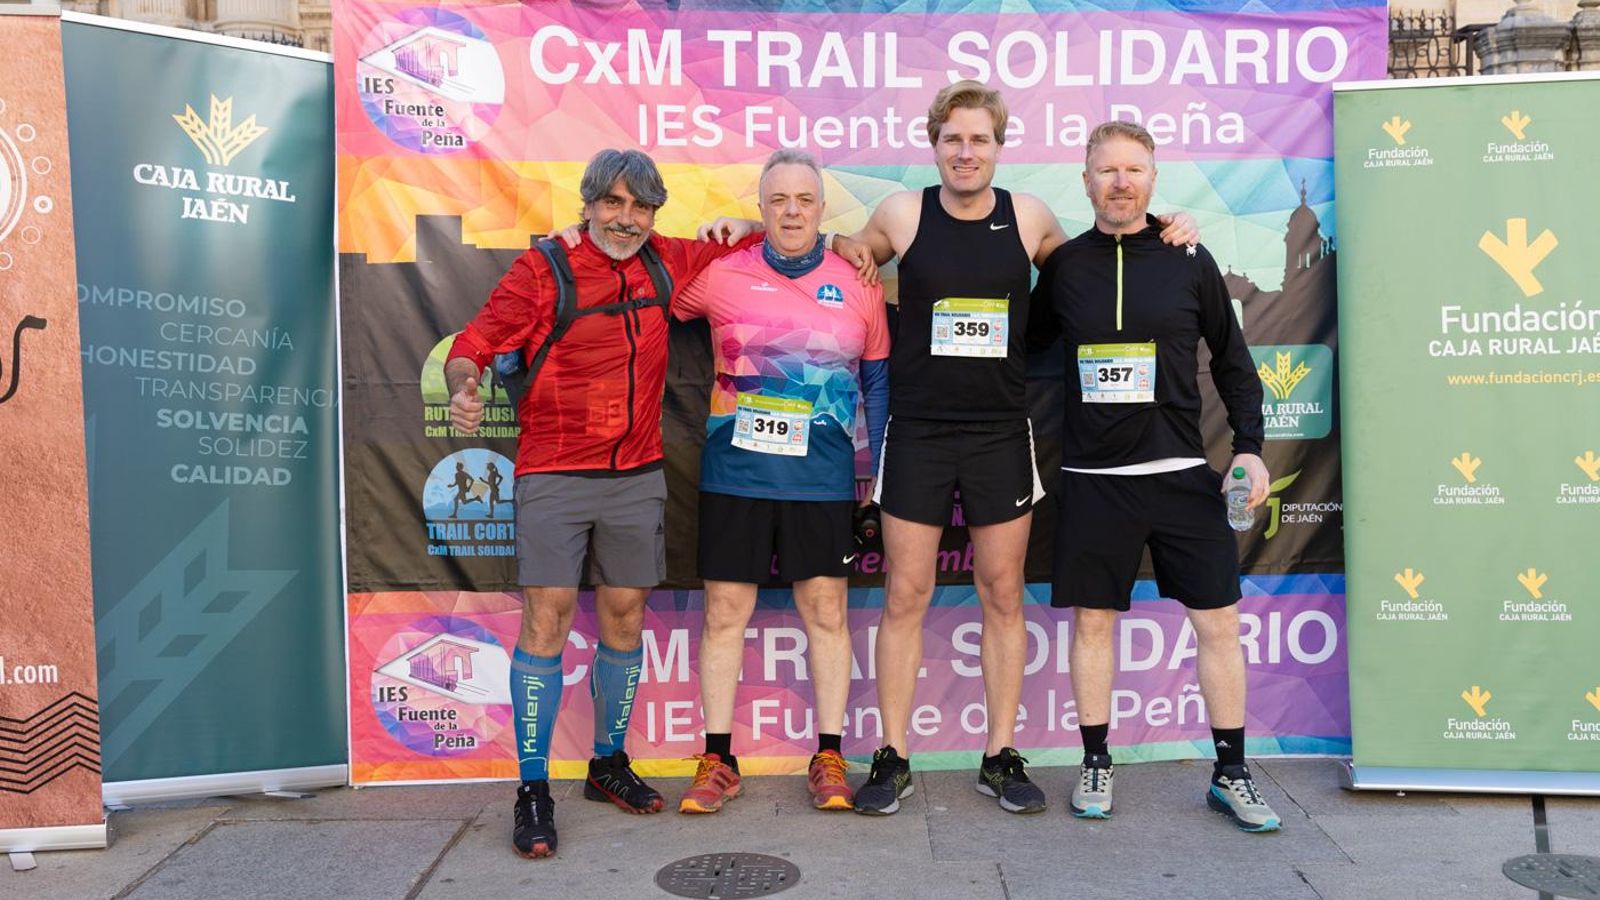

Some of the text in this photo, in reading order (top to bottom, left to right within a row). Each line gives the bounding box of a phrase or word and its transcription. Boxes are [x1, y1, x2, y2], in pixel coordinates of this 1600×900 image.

[529, 25, 1348, 88] CxM TRAIL SOLIDARIO
[365, 77, 394, 94] IES
[385, 99, 444, 117] Fuente
[421, 119, 445, 127] de la
[638, 104, 723, 147] IES
[745, 106, 932, 149] Fuente
[1003, 115, 1025, 148] e
[1045, 103, 1087, 147] la
[422, 131, 464, 147] Peña
[1368, 145, 1429, 160] Fundación
[1487, 140, 1549, 154] Fundación
[1363, 159, 1384, 168] CAJA
[1385, 158, 1412, 167] RURAL
[1482, 154, 1504, 162] CAJA
[1505, 153, 1531, 161] RURAL
[133, 163, 296, 202] CAJA RURAL
[181, 196, 250, 224] JAÉN
[160, 322, 295, 350] CERCANÍA
[954, 321, 989, 337] 359
[1429, 339, 1482, 356] CAJA
[1489, 337, 1561, 355] RURAL
[80, 344, 257, 376] HONESTIDAD
[1098, 367, 1133, 383] 357
[136, 377, 338, 408] TRANSPARENCI
[1277, 402, 1324, 416] RURAL
[157, 408, 309, 434] SOLVENCIA
[754, 417, 788, 436] 319
[1264, 415, 1299, 430] JAÉN
[425, 426, 448, 438] CxM
[198, 436, 309, 459] SOLIDEZ
[171, 463, 292, 486] CALIDAD
[1438, 483, 1500, 496] Fundación
[1281, 502, 1343, 512] DIPUTACIÓN
[1455, 496, 1482, 504] RURAL
[1281, 513, 1323, 523] DE JAÉN
[426, 522, 472, 540] TRAIL
[449, 545, 476, 556] TRAIL
[1381, 600, 1443, 612] Fundación
[1503, 600, 1567, 613] Fundación
[1376, 613, 1397, 621] CAJA
[1399, 612, 1425, 621] RURAL
[1499, 613, 1520, 621] CAJA
[1521, 613, 1548, 621] RURAL
[379, 686, 408, 702] IES
[398, 706, 457, 721] Fuente
[646, 700, 707, 742] IE
[1111, 683, 1205, 730] Peñ
[434, 722, 458, 731] de la
[1448, 718, 1510, 731] Fundación
[434, 733, 476, 748] Peña
[1443, 731, 1464, 739] CAJA
[1465, 732, 1493, 740] RURAL
[1567, 733, 1589, 741] CAJA
